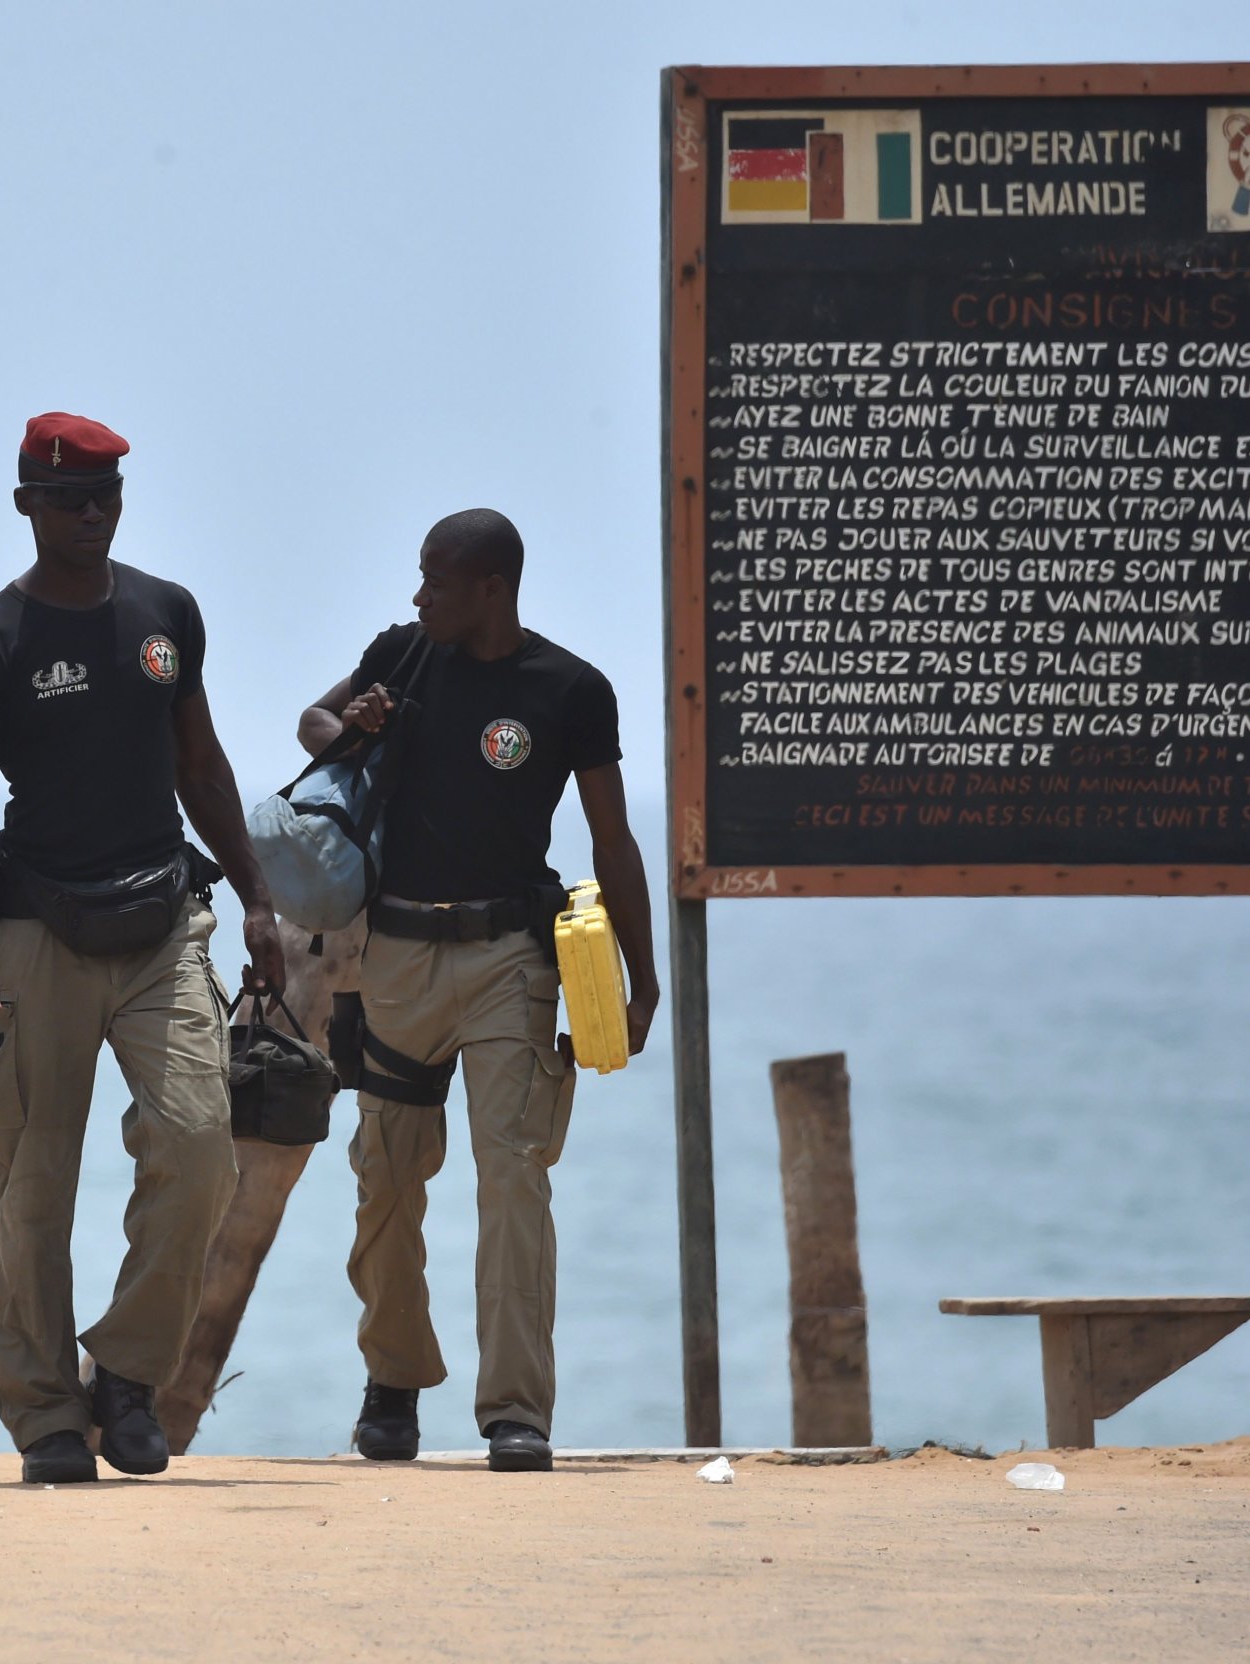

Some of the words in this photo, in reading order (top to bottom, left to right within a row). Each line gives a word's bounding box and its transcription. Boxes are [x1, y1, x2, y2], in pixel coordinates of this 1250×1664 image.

[930, 181, 1146, 217] ALLEMANDE
[730, 342, 883, 367] RESPECTEZ
[890, 342, 1108, 367] STRICTEMENT
[1118, 342, 1168, 367] LES
[731, 373, 891, 398] RESPECTEZ
[900, 373, 934, 398] LA
[944, 373, 1067, 398] COULEUR
[1075, 373, 1110, 398] DU
[1118, 373, 1210, 398] FANION
[733, 404, 802, 428] AYEZ
[810, 404, 857, 428] UNE
[868, 404, 953, 428] BONNE
[966, 404, 1058, 428] TENUE
[1068, 404, 1102, 428] DE
[1112, 404, 1170, 428] BAIN
[737, 435, 772, 459] SE
[781, 435, 891, 459] BAIGNER
[984, 435, 1015, 459] LA
[1024, 435, 1221, 459] SURVEILLANCE
[734, 466, 823, 490] EVITER
[828, 466, 857, 490] LA
[863, 466, 1102, 490] CONSOMMATION
[1109, 466, 1163, 490] DES
[736, 496, 830, 521] EVITER
[837, 496, 885, 521] LES
[892, 496, 978, 521] REPAS
[989, 496, 1101, 521] COPIEUX
[1108, 494, 1196, 522] (TROP
[737, 527, 768, 551] NE
[776, 527, 827, 551] PAS
[838, 527, 931, 551] JOUER
[937, 527, 990, 551] AUX
[996, 527, 1181, 551] SAUVETEURS
[1190, 527, 1216, 551] SI
[738, 558, 787, 583] LES
[796, 558, 893, 583] PECHES
[899, 558, 932, 583] DE
[940, 558, 1012, 583] TOUS
[1017, 558, 1116, 583] GENRES
[1123, 558, 1198, 583] SONT
[739, 588, 836, 613] EVITER
[840, 588, 887, 613] LES
[892, 588, 988, 613] ACTES
[1001, 588, 1035, 613] DE
[1045, 588, 1223, 613] VANDALISME
[739, 619, 830, 645] EVITER
[834, 619, 863, 645] LA
[869, 619, 1006, 645] PRESENCE
[1013, 619, 1066, 645] DES
[1074, 619, 1200, 645] ANIMAUX
[740, 651, 774, 676] NE
[780, 651, 910, 676] SALISSEZ
[917, 651, 973, 676] PAS
[978, 651, 1028, 676] LES
[1036, 651, 1142, 676] PLAGES
[37, 683, 90, 700] ARTIFICIER
[741, 681, 945, 706] STATIONNEMENT
[953, 681, 1002, 706] DES
[1008, 681, 1139, 706] VEHICULES
[1145, 681, 1179, 706] DE
[740, 712, 823, 737] FACILE
[826, 712, 871, 737] AUX
[873, 712, 1044, 737] AMBULANCES
[1052, 712, 1085, 737] EN
[1088, 712, 1143, 737] CAS
[741, 742, 869, 766] BAIGNADE
[873, 742, 1014, 766] AUTORISEE
[1020, 742, 1054, 766] DE
[966, 774, 1032, 795] DANS
[1039, 774, 1070, 795] UN
[1078, 774, 1200, 795] MINIMUM
[859, 804, 908, 828] EST
[918, 804, 951, 828] UN
